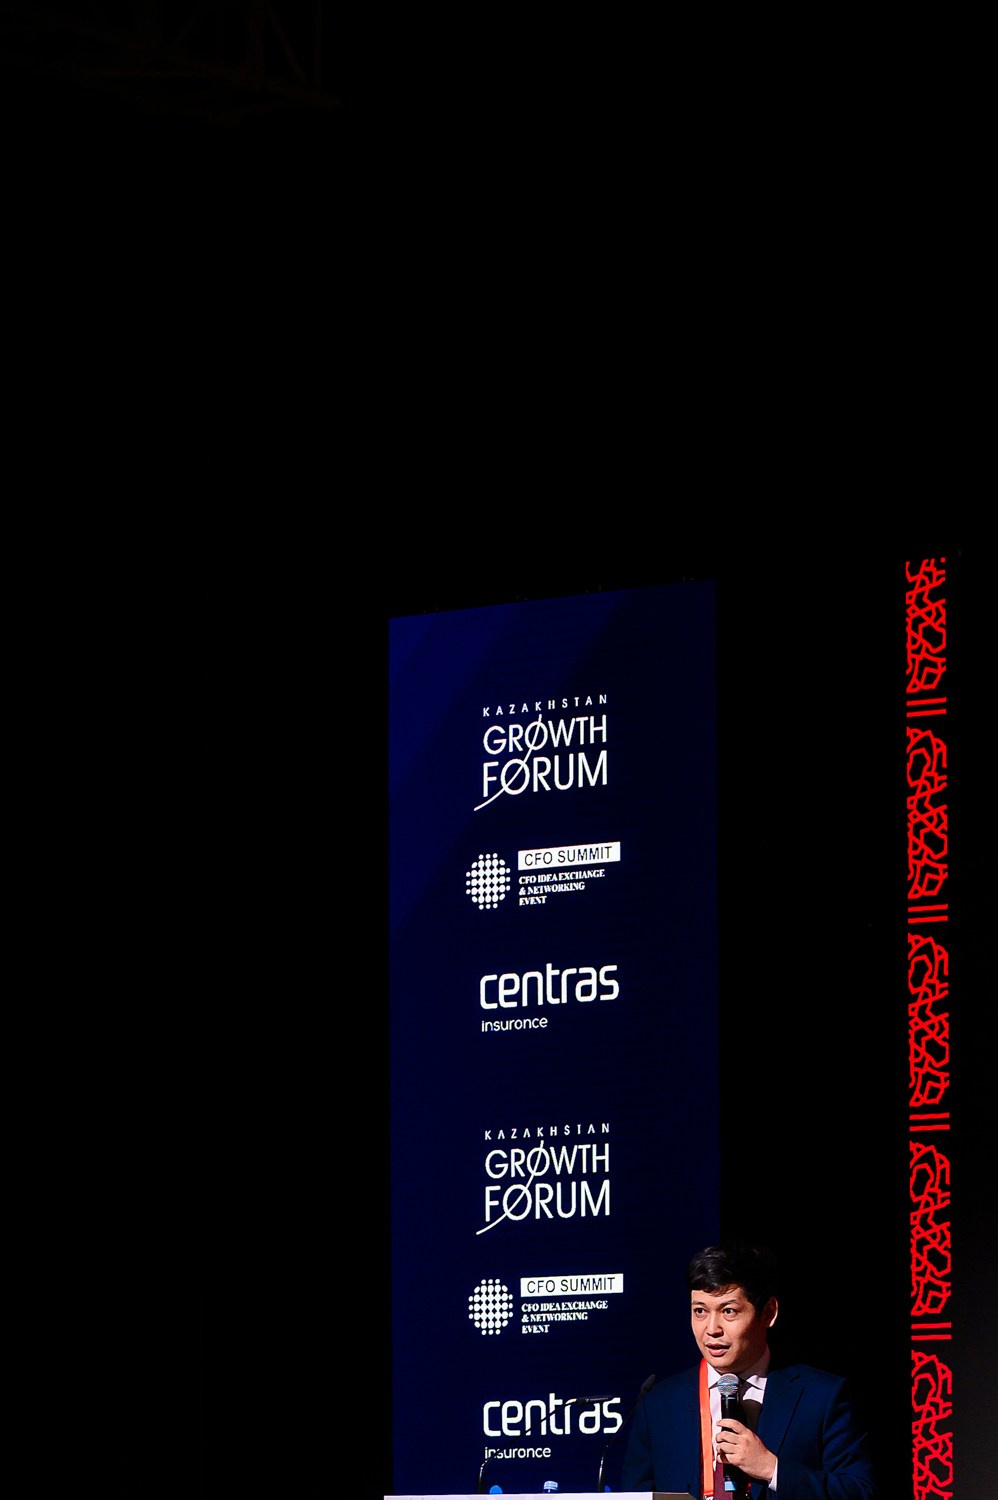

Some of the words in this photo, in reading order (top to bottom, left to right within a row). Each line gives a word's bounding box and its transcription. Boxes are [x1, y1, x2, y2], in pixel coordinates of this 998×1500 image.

[482, 694, 608, 717] KAZAKHSTAN
[524, 851, 553, 866] CFO
[557, 846, 613, 863] SUMMIT
[518, 875, 537, 884] CFO
[538, 873, 558, 883] IDEA
[558, 869, 605, 880] EXCHANGE
[518, 887, 526, 896] &
[527, 881, 586, 895] NETWORKING
[518, 896, 547, 906] EVENT
[480, 963, 620, 1010] centras
[485, 1122, 611, 1141] KAZAKHSTAN
[527, 1280, 556, 1294] CFO
[560, 1277, 616, 1293] SUMMIT
[521, 1303, 540, 1313] CFO
[541, 1302, 561, 1312] IDEA
[561, 1300, 609, 1311] EXCHANGE
[521, 1314, 529, 1323] &
[530, 1311, 588, 1323] NETWORKING
[521, 1324, 551, 1334] EVENT
[483, 1393, 623, 1437] centras
